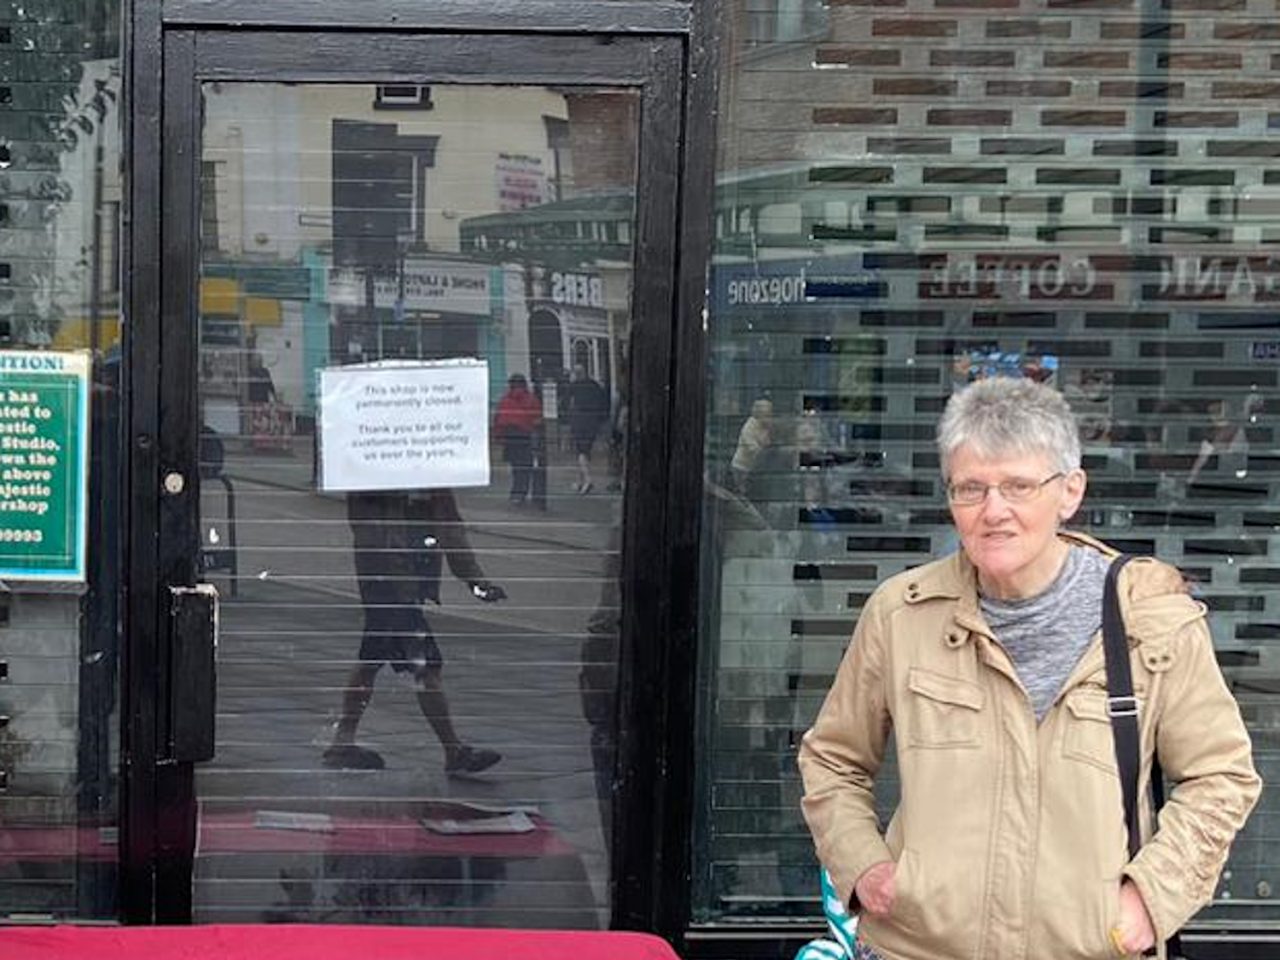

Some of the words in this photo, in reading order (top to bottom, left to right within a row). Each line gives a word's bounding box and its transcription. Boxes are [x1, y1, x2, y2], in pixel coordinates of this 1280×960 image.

[8, 389, 38, 402] has
[365, 385, 387, 395] This
[34, 405, 52, 419] to
[359, 424, 390, 434] Thank
[393, 426, 413, 435] you
[28, 453, 57, 466] the
[2, 467, 52, 481] above
